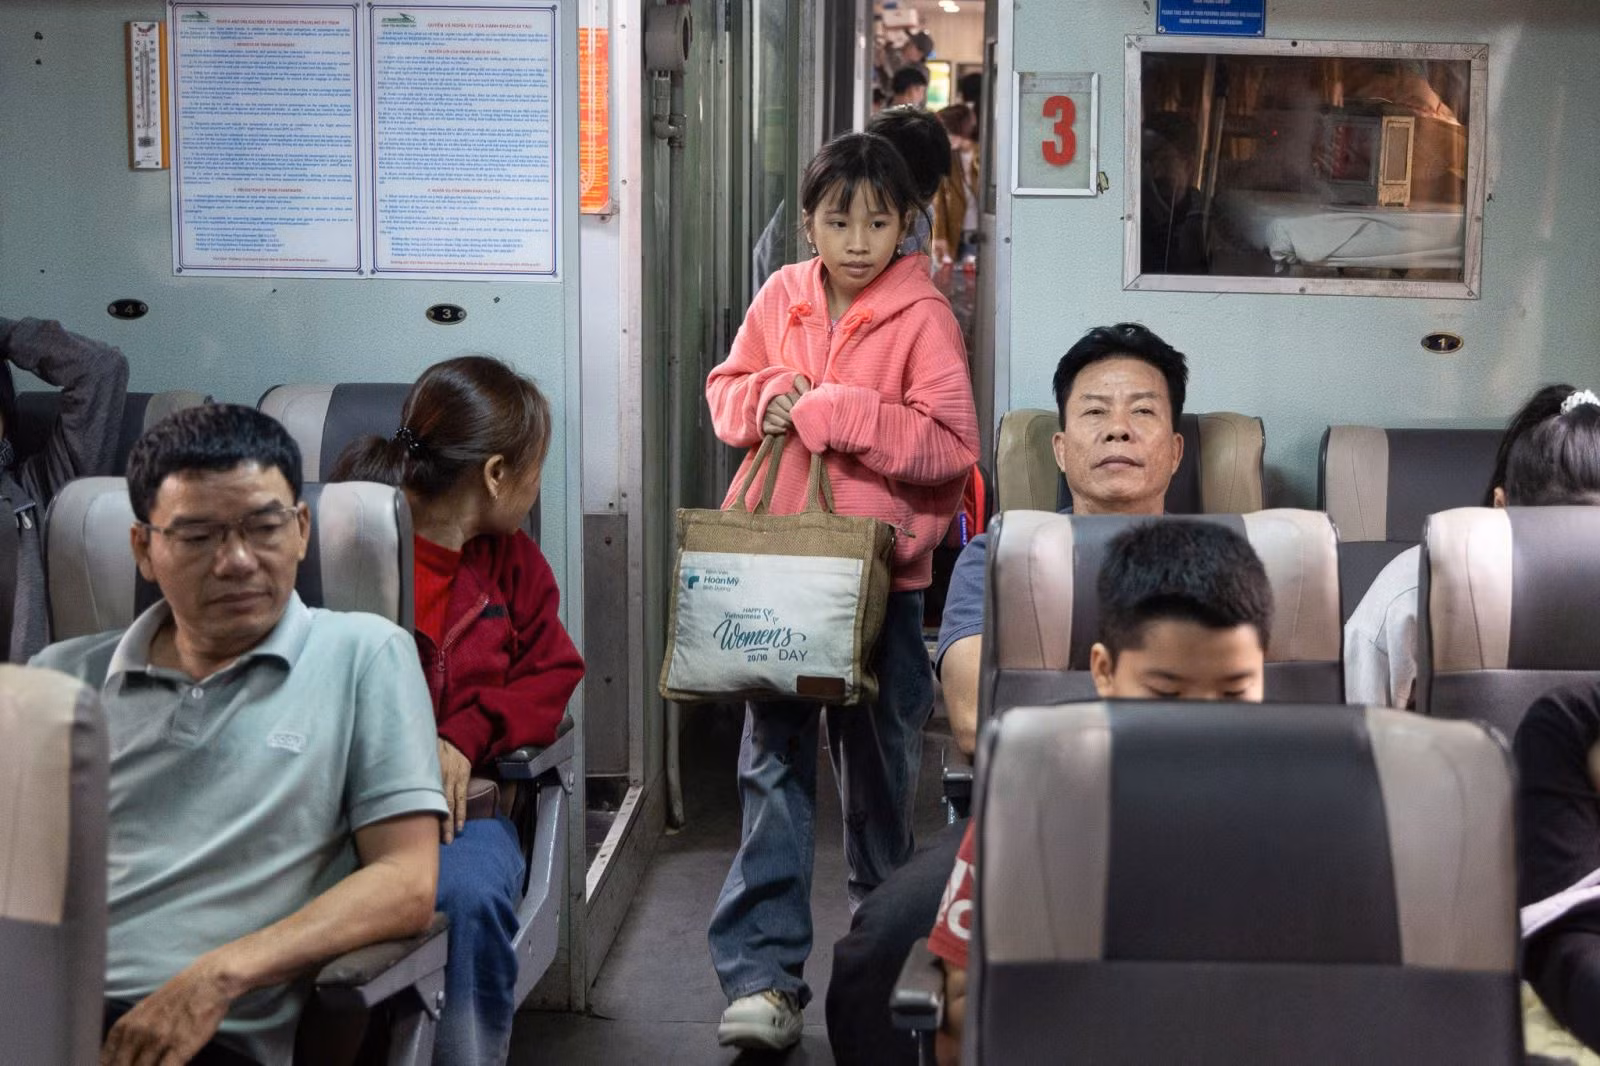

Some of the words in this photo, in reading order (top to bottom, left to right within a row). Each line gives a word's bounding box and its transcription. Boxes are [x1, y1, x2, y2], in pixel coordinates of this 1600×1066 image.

[1042, 95, 1076, 167] 3
[124, 304, 134, 315] 4
[442, 308, 452, 319] 3
[1437, 337, 1446, 350] 1
[703, 575, 726, 584] Hoàn
[726, 575, 740, 586] Mỹ
[724, 611, 761, 619] Vietnamese
[712, 619, 807, 650] Women's
[747, 653, 768, 662] 20/10
[778, 649, 808, 662] DAY
